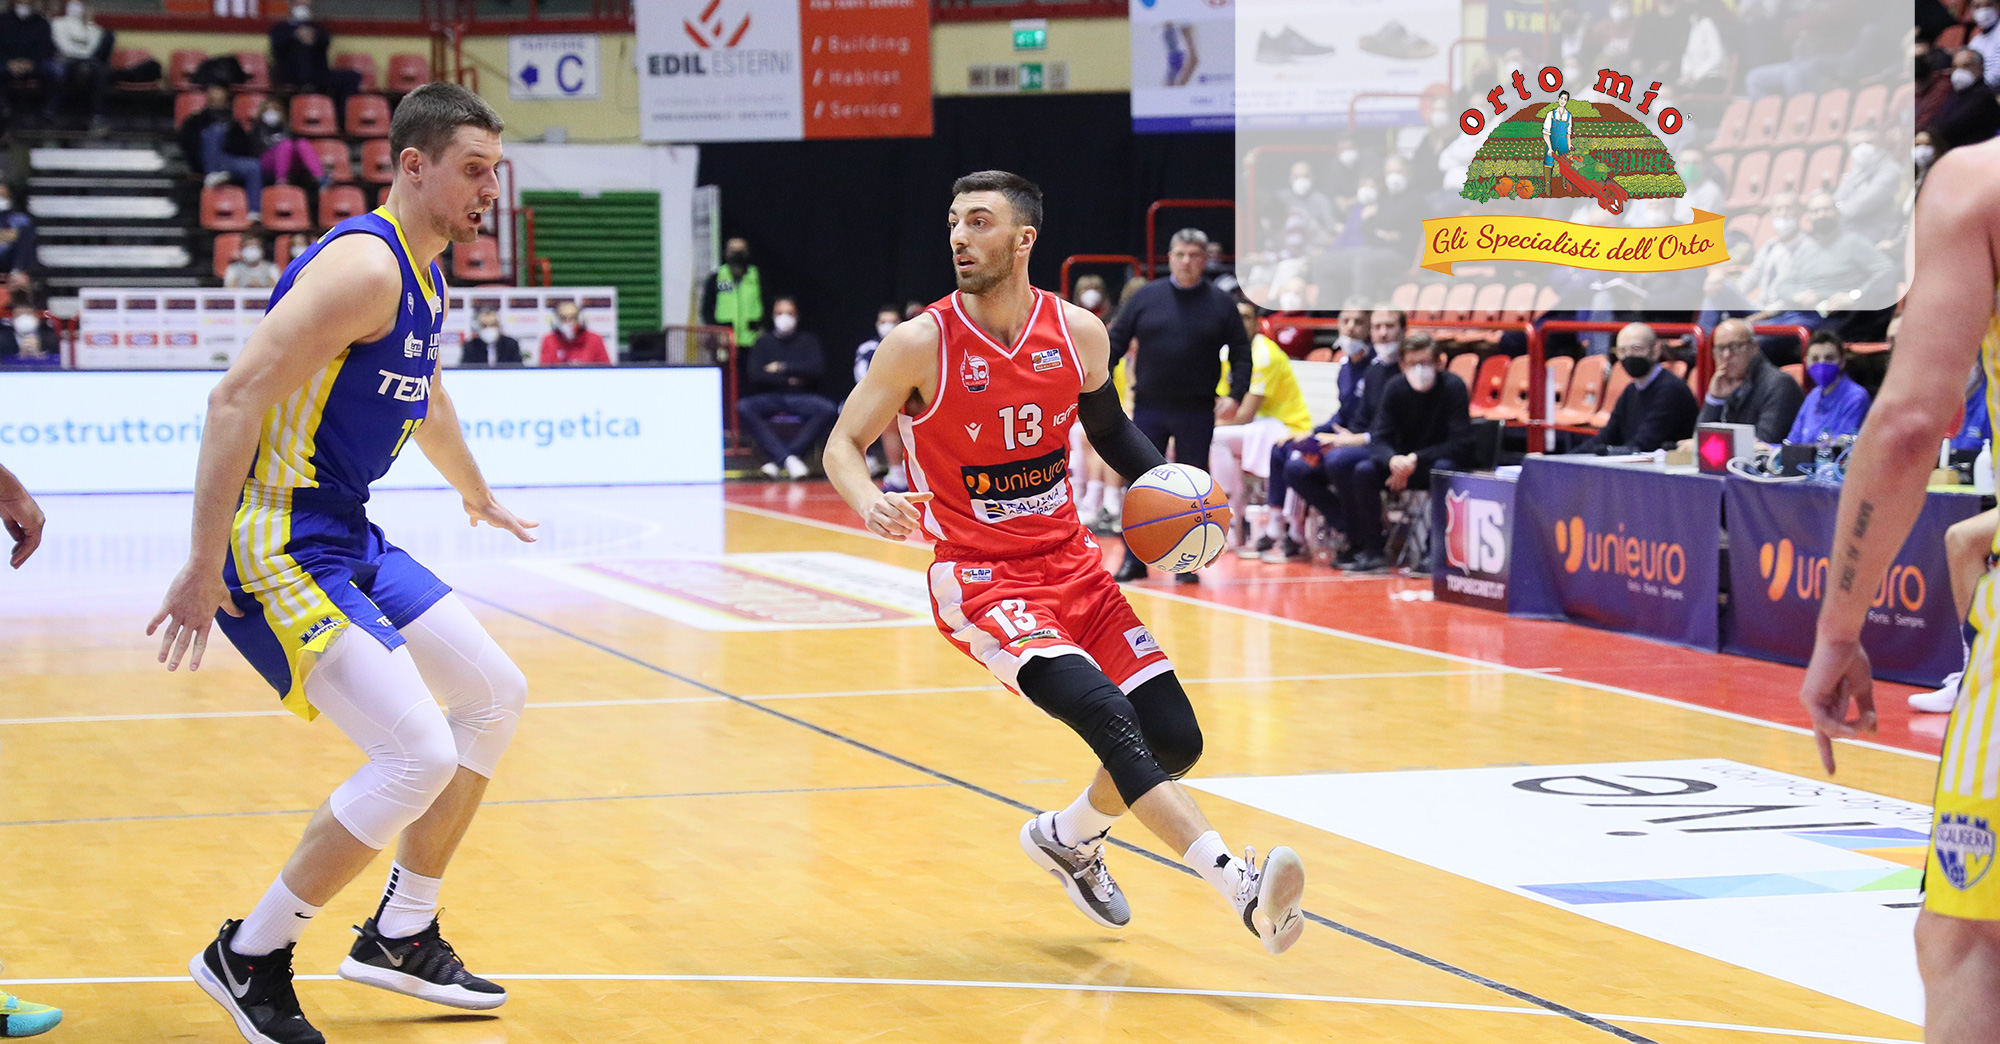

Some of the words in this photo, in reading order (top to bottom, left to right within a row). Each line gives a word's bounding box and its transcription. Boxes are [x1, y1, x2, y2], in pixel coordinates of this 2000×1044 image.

[648, 52, 707, 76] EDIL
[711, 50, 791, 76] ESTERNI
[828, 34, 911, 56] Building
[556, 54, 584, 94] C
[829, 100, 901, 119] Service
[0, 414, 202, 444] costruttori
[460, 411, 640, 447] energetica
[998, 403, 1043, 451] 13
[994, 458, 1066, 492] unieuro
[1586, 522, 1686, 586] unieuro
[1796, 554, 1926, 612] unuro
[985, 599, 1037, 640] 13
